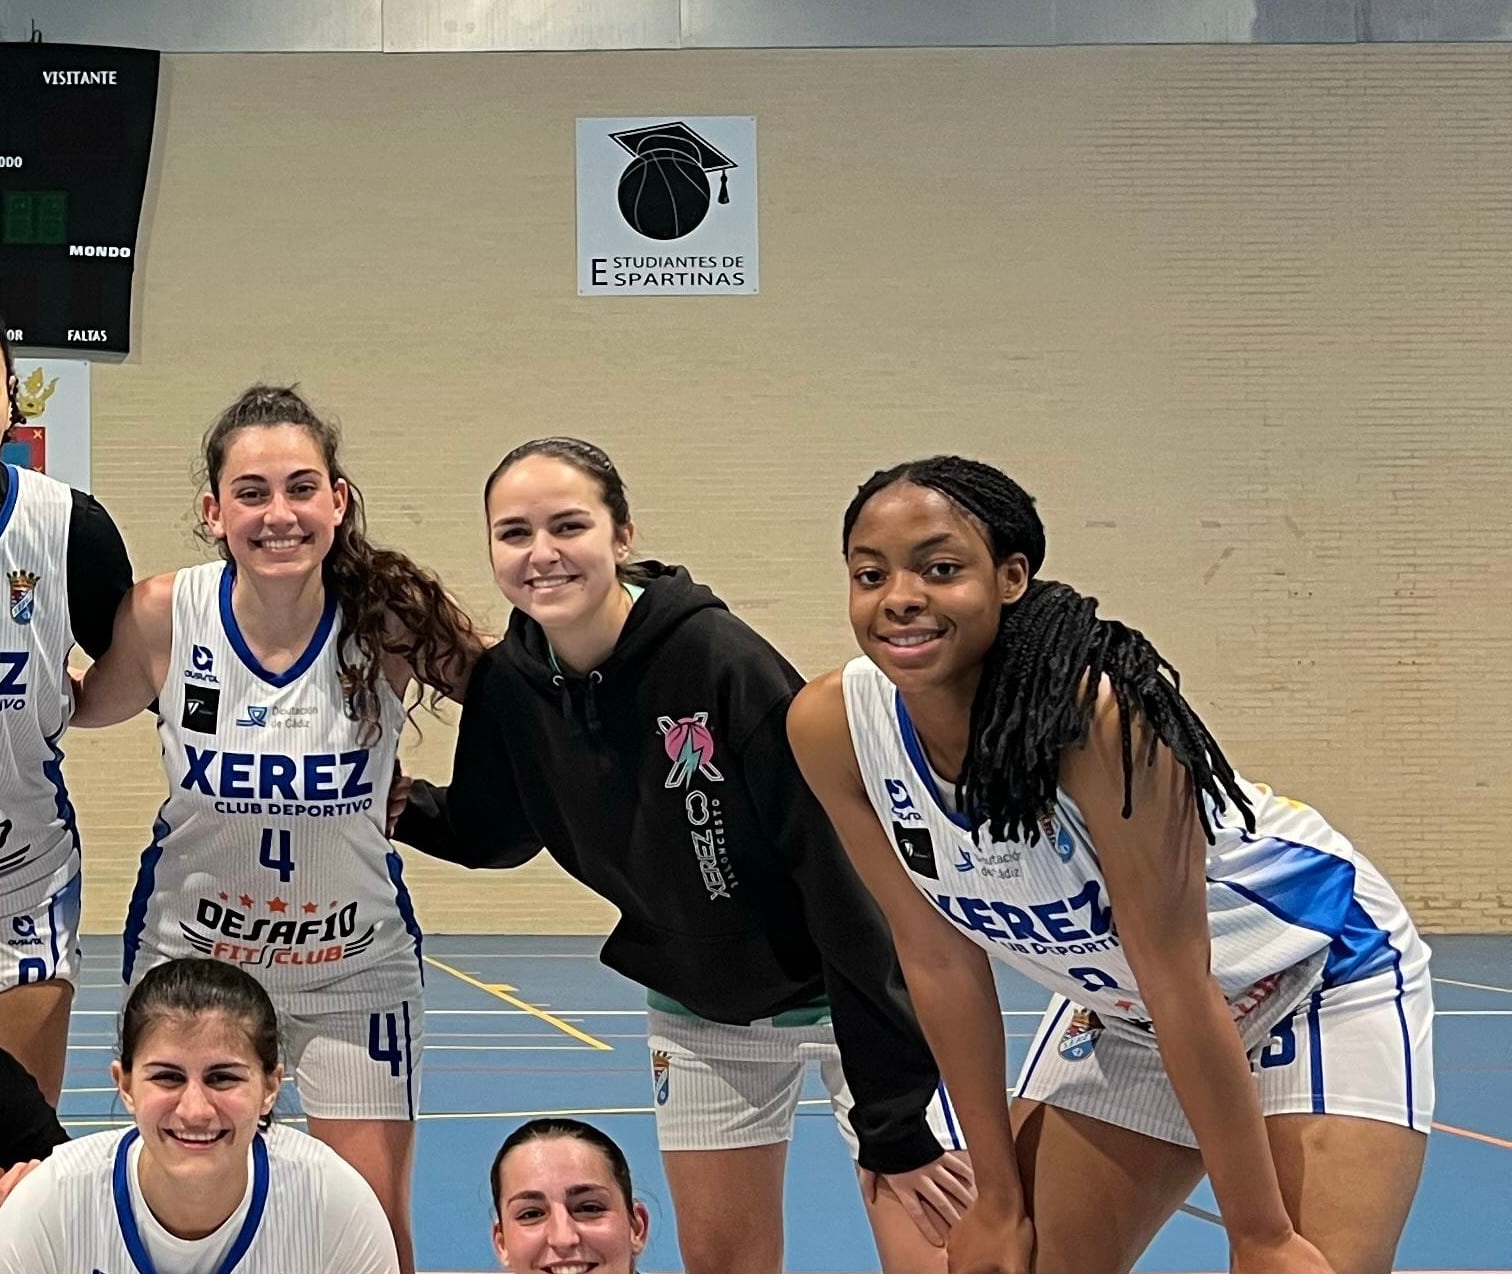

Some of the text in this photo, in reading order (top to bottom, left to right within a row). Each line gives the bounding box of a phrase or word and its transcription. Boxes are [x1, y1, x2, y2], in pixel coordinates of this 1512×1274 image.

[42, 70, 118, 85] VISITANTE
[68, 245, 131, 258] MONDO
[723, 256, 744, 268] DE
[67, 329, 108, 342] FALTAS
[271, 705, 319, 717] Diputación
[180, 744, 373, 801] XEREZ
[214, 797, 373, 817] CLUB DEPORTIVO
[258, 827, 295, 883] 4
[196, 897, 358, 945] DESAFIO
[923, 880, 1113, 943] XEREZ
[211, 942, 345, 966] FIT CLUB
[1035, 935, 1120, 957] DPORTI
[368, 1012, 404, 1077] 4
